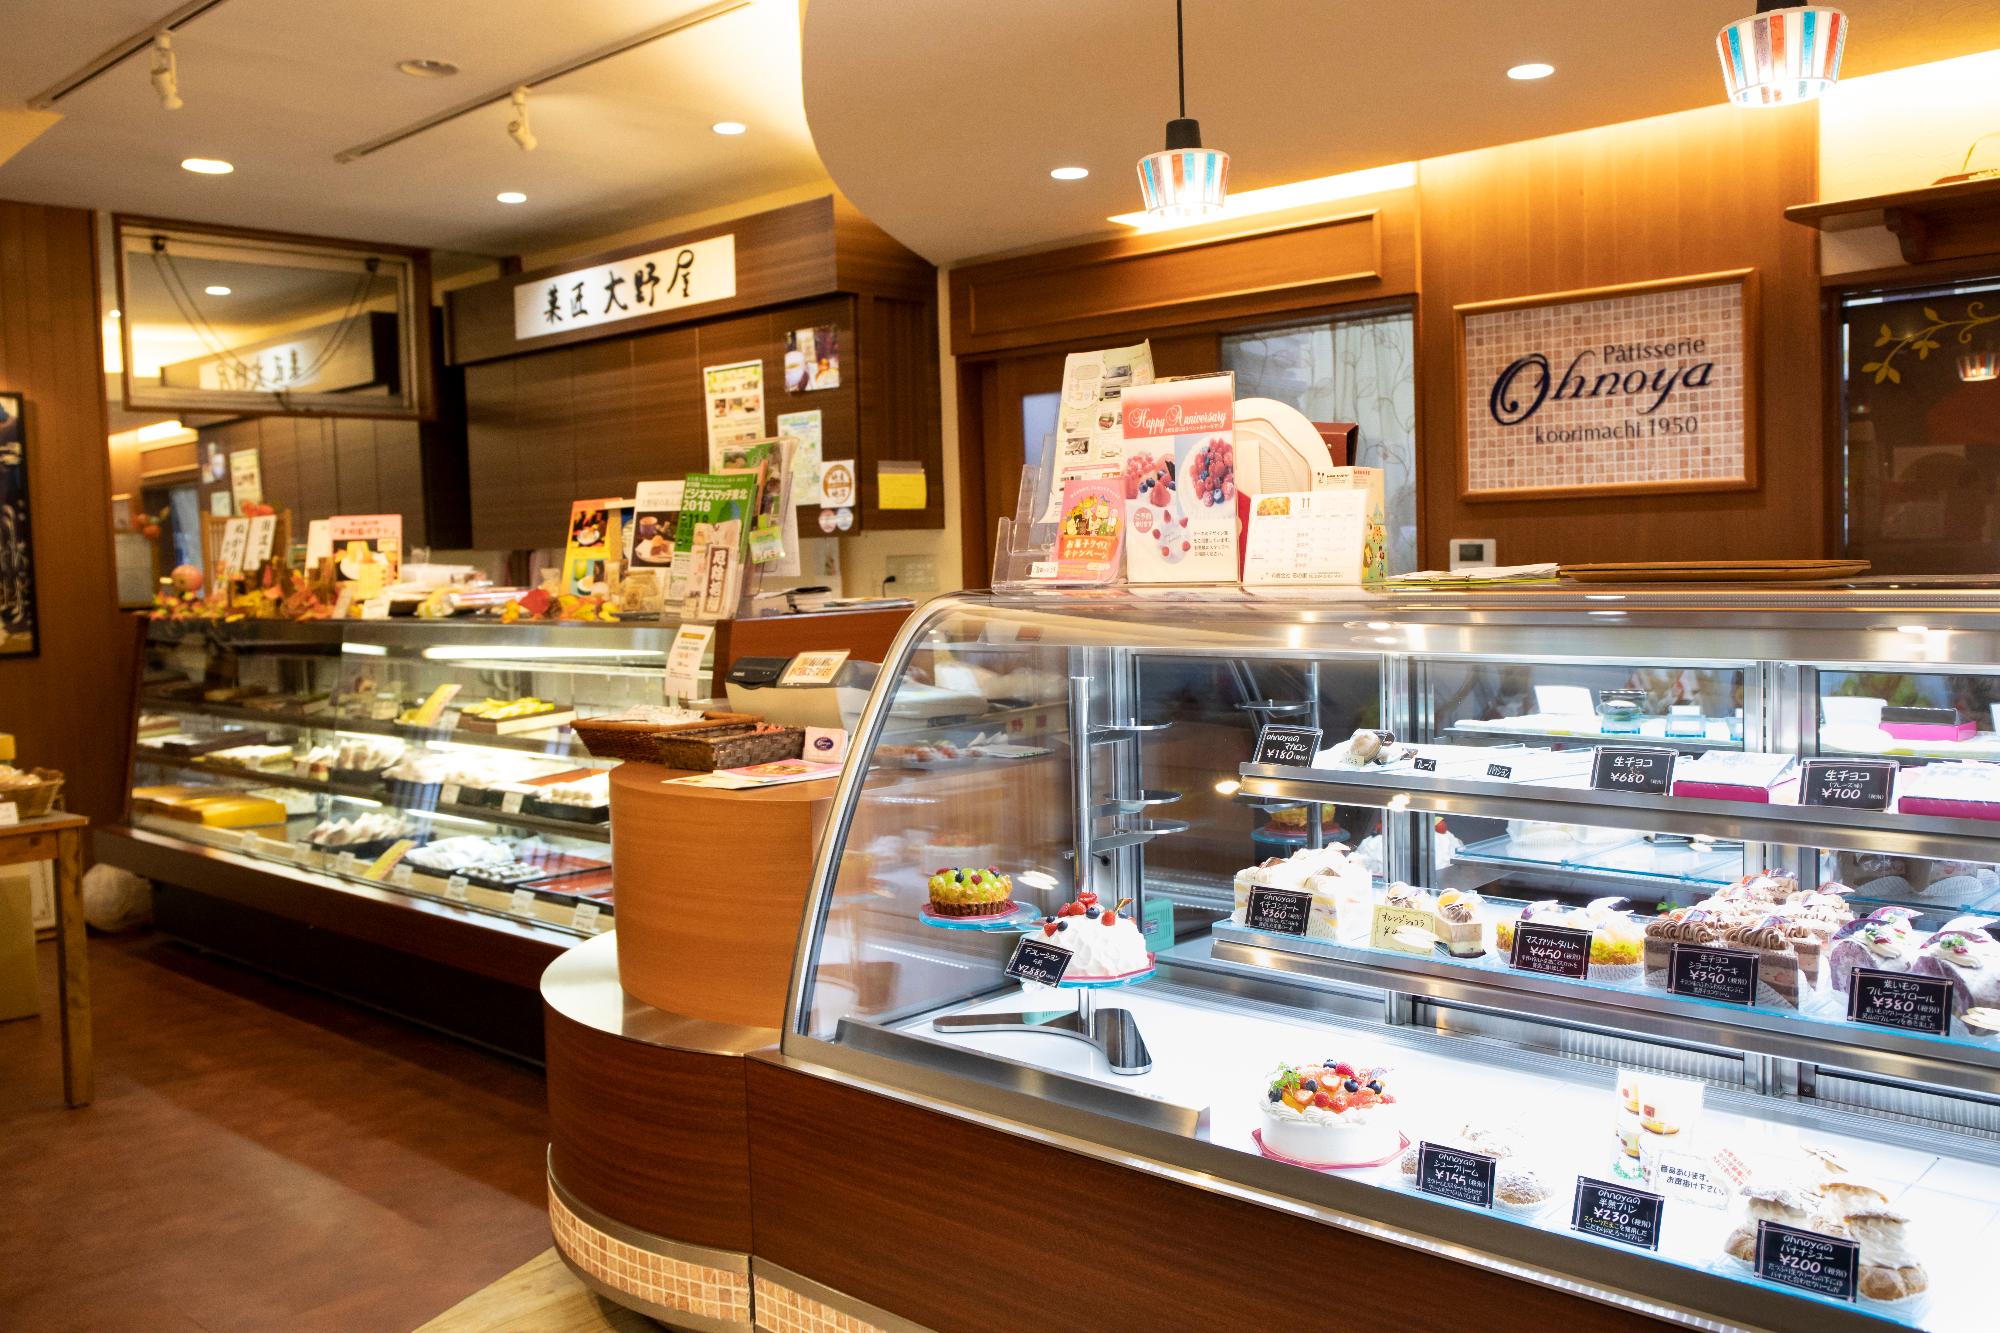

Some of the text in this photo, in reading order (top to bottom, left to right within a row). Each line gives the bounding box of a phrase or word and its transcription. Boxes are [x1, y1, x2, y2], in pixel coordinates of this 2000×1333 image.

[1603, 337, 1705, 364] Pâtisserie
[1489, 350, 1714, 426] Ohnoya
[1128, 402, 1226, 434] Happy Anniversary
[1535, 416, 1698, 444] koorimachi 1950
[682, 500, 711, 512] 2018
[1267, 749, 1294, 760] ¥180
[1285, 743, 1308, 752] マカロン
[1613, 755, 1653, 768] 生チョコ
[1610, 772, 1645, 783] ¥680
[1824, 769, 1870, 781] 生チョコ
[1821, 788, 1861, 799] ¥700
[1259, 901, 1299, 912] イチゴショート
[1262, 908, 1287, 919] ¥360
[1525, 935, 1580, 950] マスカットタルト
[1530, 946, 1562, 960] ¥450
[1700, 954, 1729, 964] 生チョコ
[1688, 961, 1739, 976] ショートケーキ
[1690, 970, 1725, 984] ¥390
[1883, 979, 1920, 991] 紫いもの
[1866, 986, 1936, 1003] フルーティロール
[1872, 996, 1914, 1012] ¥380
[1438, 1153, 1476, 1167] ohnoyaの
[1434, 1160, 1479, 1177] シュークリーム
[1435, 1168, 1466, 1186] ¥155
[1597, 1189, 1641, 1205] ohnoyaの
[1598, 1198, 1638, 1213] 半熟プリン
[1593, 1207, 1629, 1224] ¥230
[1783, 1235, 1833, 1252] ohnoyaの
[1780, 1244, 1835, 1260] バナナシュー
[1779, 1253, 1821, 1273] ¥200
